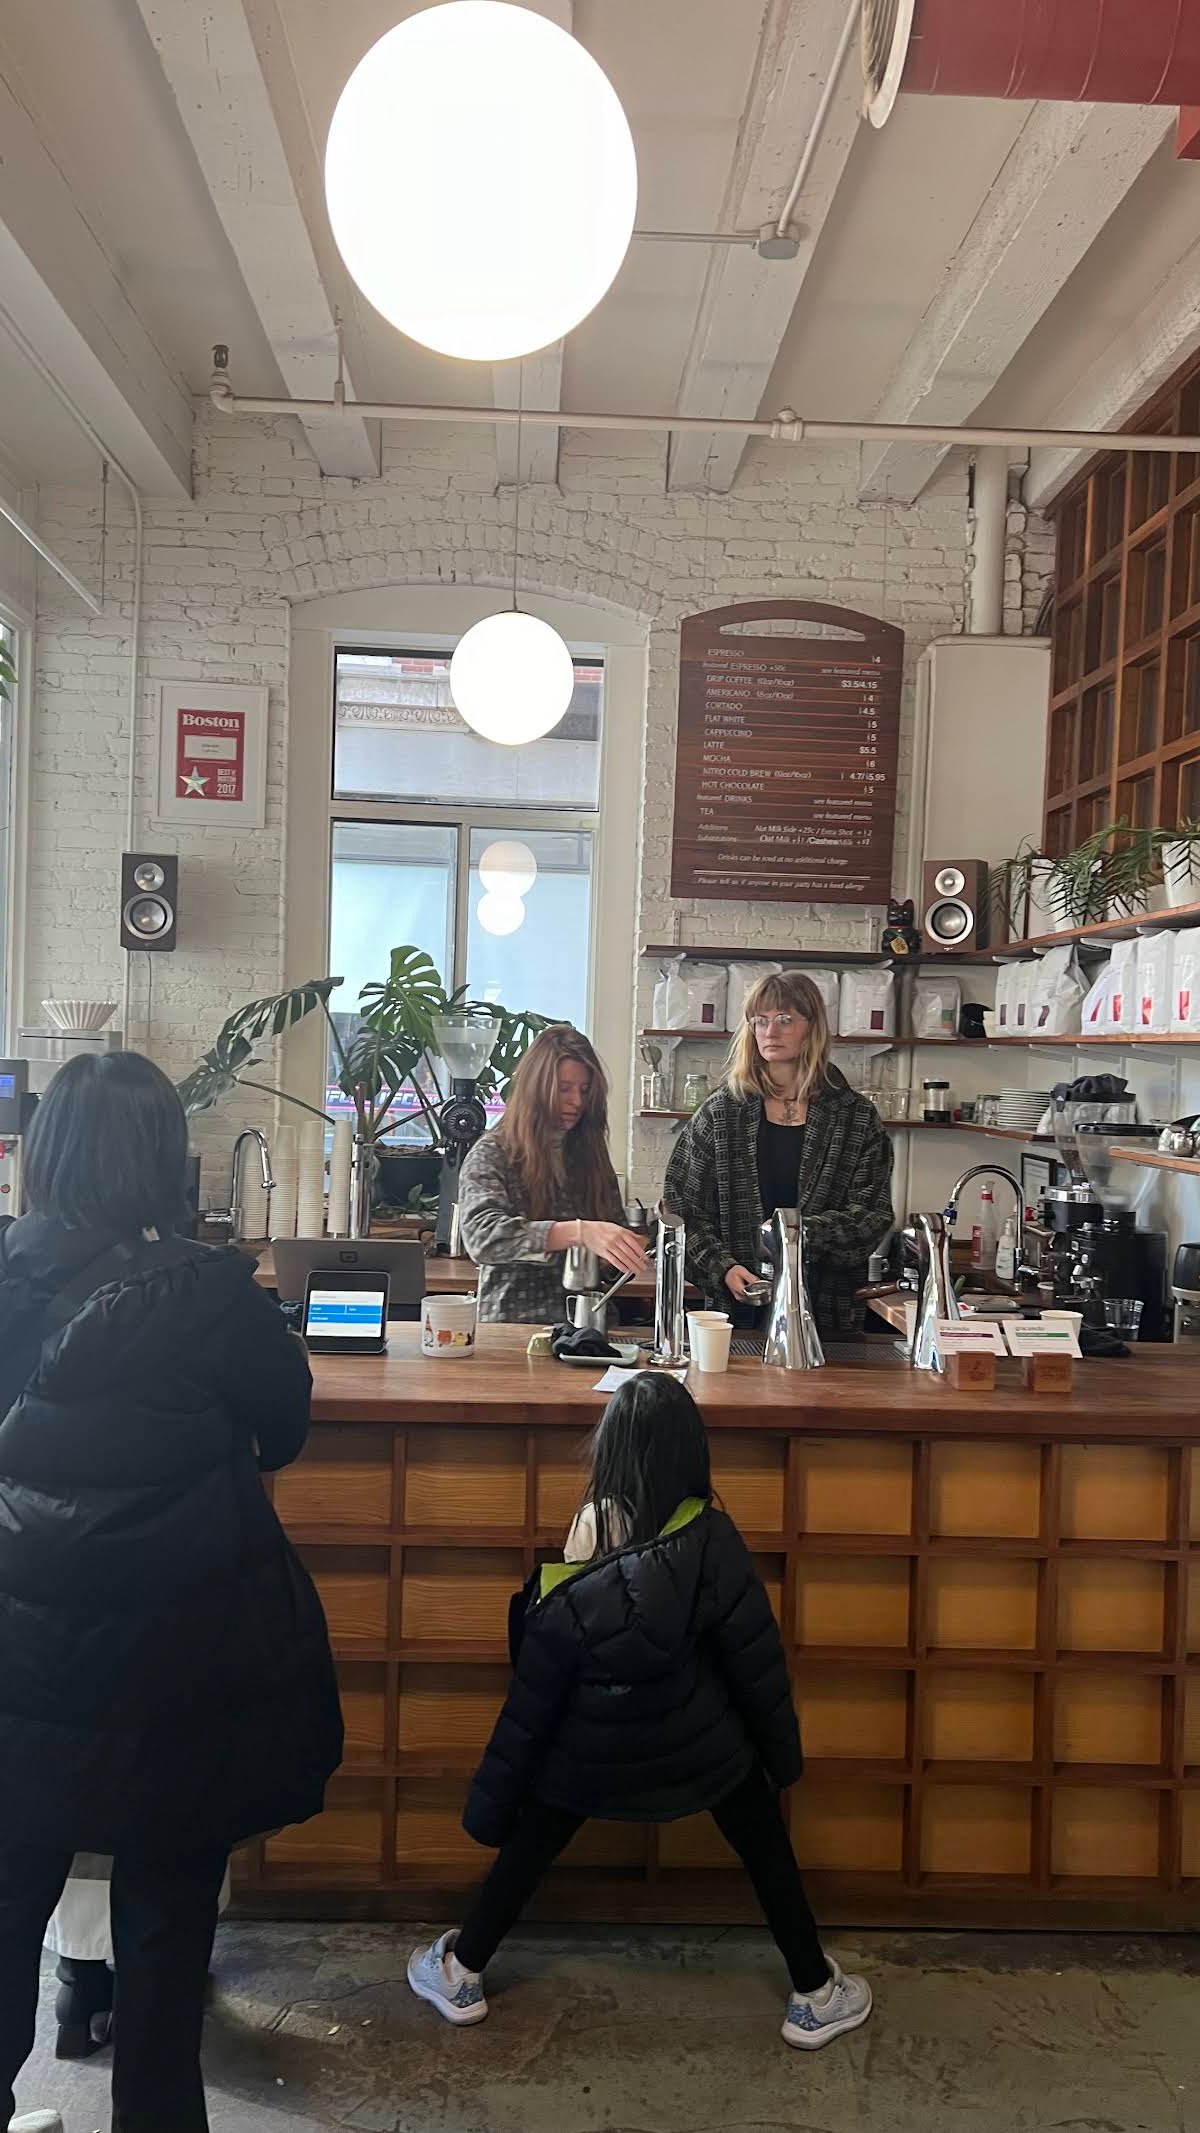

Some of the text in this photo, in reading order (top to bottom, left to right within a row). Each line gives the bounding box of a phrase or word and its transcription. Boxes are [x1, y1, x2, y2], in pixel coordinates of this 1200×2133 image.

[707, 648, 744, 657] ESPRESSO
[730, 662, 767, 671] ESPRESSO
[725, 675, 752, 684] COFFEE
[706, 688, 750, 697] AMERICANO
[705, 701, 743, 710] CORTADO
[182, 713, 240, 728] Boston
[704, 714, 745, 724] FLAT WHITE
[704, 728, 753, 738] CAPPUCCINO
[703, 741, 725, 749] LATTE
[859, 746, 877, 754] $5.5
[702, 754, 731, 763] MOCHA
[702, 767, 726, 776] NITRO
[727, 768, 748, 777] COLD
[750, 769, 772, 777] BREW
[217, 783, 237, 794] 2017
[701, 781, 765, 791] HOT CHOCOLATE
[724, 795, 753, 803] DRINKS
[761, 855, 776, 863] iced
[827, 857, 848, 867] charge
[794, 881, 811, 889] party
[828, 881, 845, 889] food
[844, 882, 865, 891] allergy
